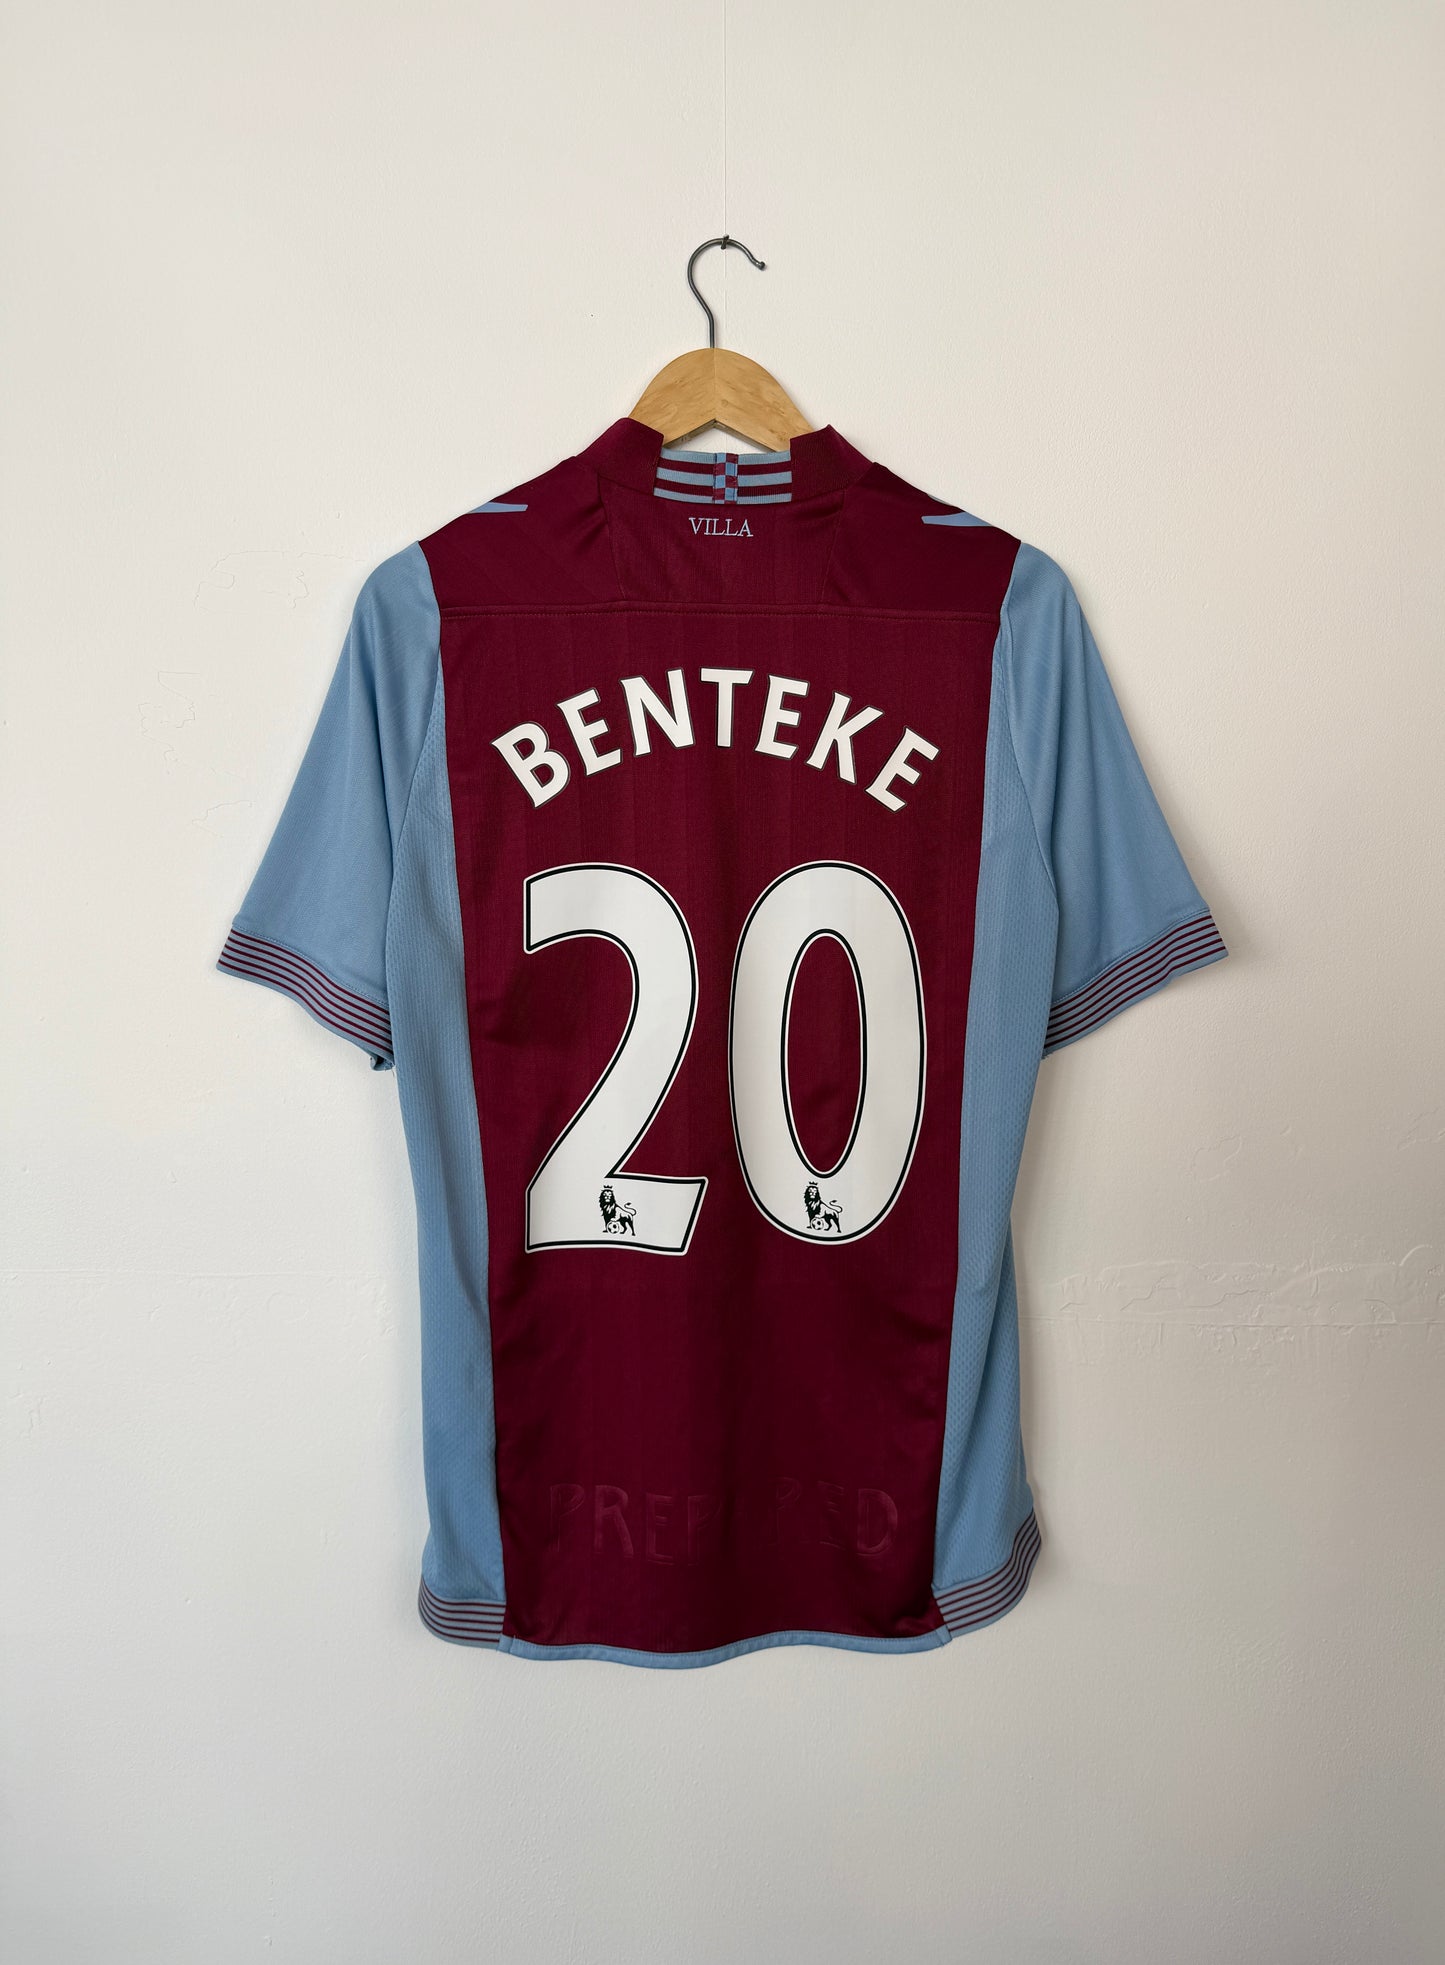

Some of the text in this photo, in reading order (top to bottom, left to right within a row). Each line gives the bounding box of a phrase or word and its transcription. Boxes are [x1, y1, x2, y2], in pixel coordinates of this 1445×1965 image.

[688, 517, 754, 537] VILLA
[491, 667, 940, 813] BENTEKE
[524, 860, 927, 1255] 20
[549, 1476, 899, 1566] PREPRED
